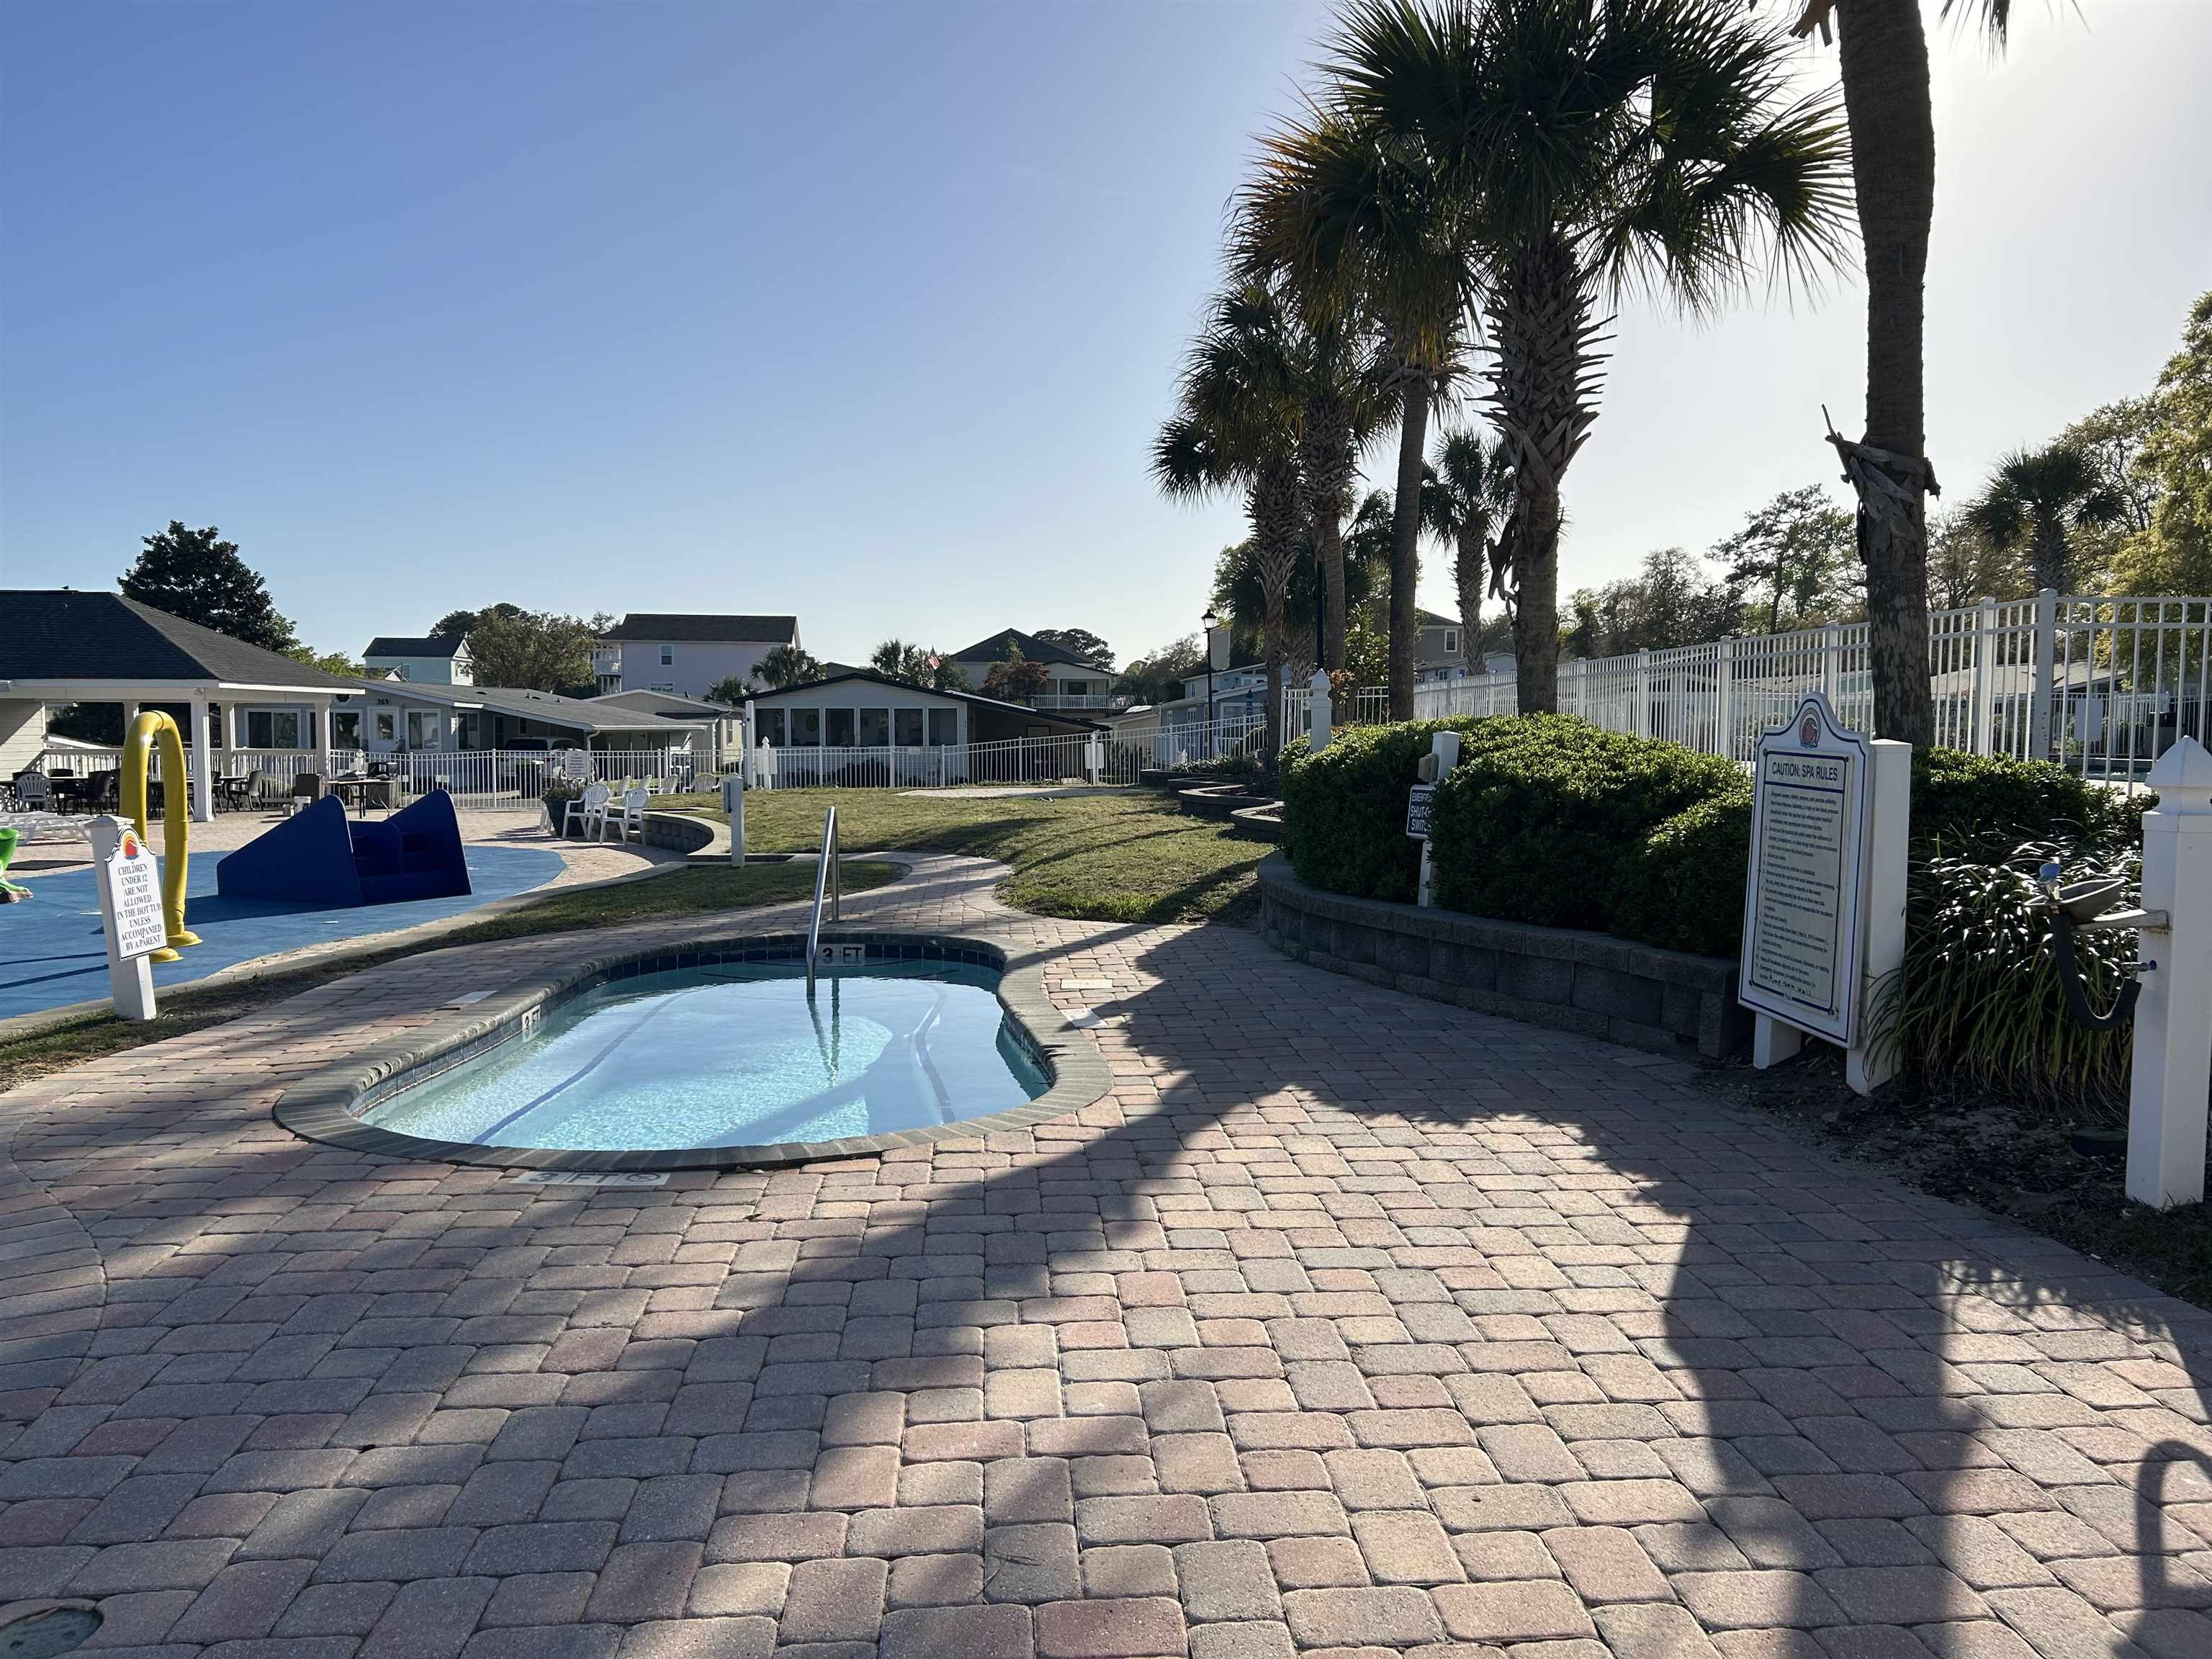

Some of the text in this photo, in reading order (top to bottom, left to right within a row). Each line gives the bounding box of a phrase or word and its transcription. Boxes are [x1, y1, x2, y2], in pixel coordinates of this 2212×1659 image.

[1772, 762, 1838, 781] CAUTION: SPA RULES
[118, 863, 148, 876] CHILDREN
[121, 873, 149, 886] UNDER 12
[124, 884, 149, 896] ARE NOT
[124, 894, 152, 907] ALLOWED
[117, 903, 161, 920] IN THE HOT TUB
[129, 916, 151, 928] UNLESS
[122, 924, 162, 941] ACCOMPANIED
[125, 941, 134, 951] BY
[138, 935, 161, 948] PARENT
[842, 947, 863, 957] FT
[528, 1172, 619, 1184] 3 FT
